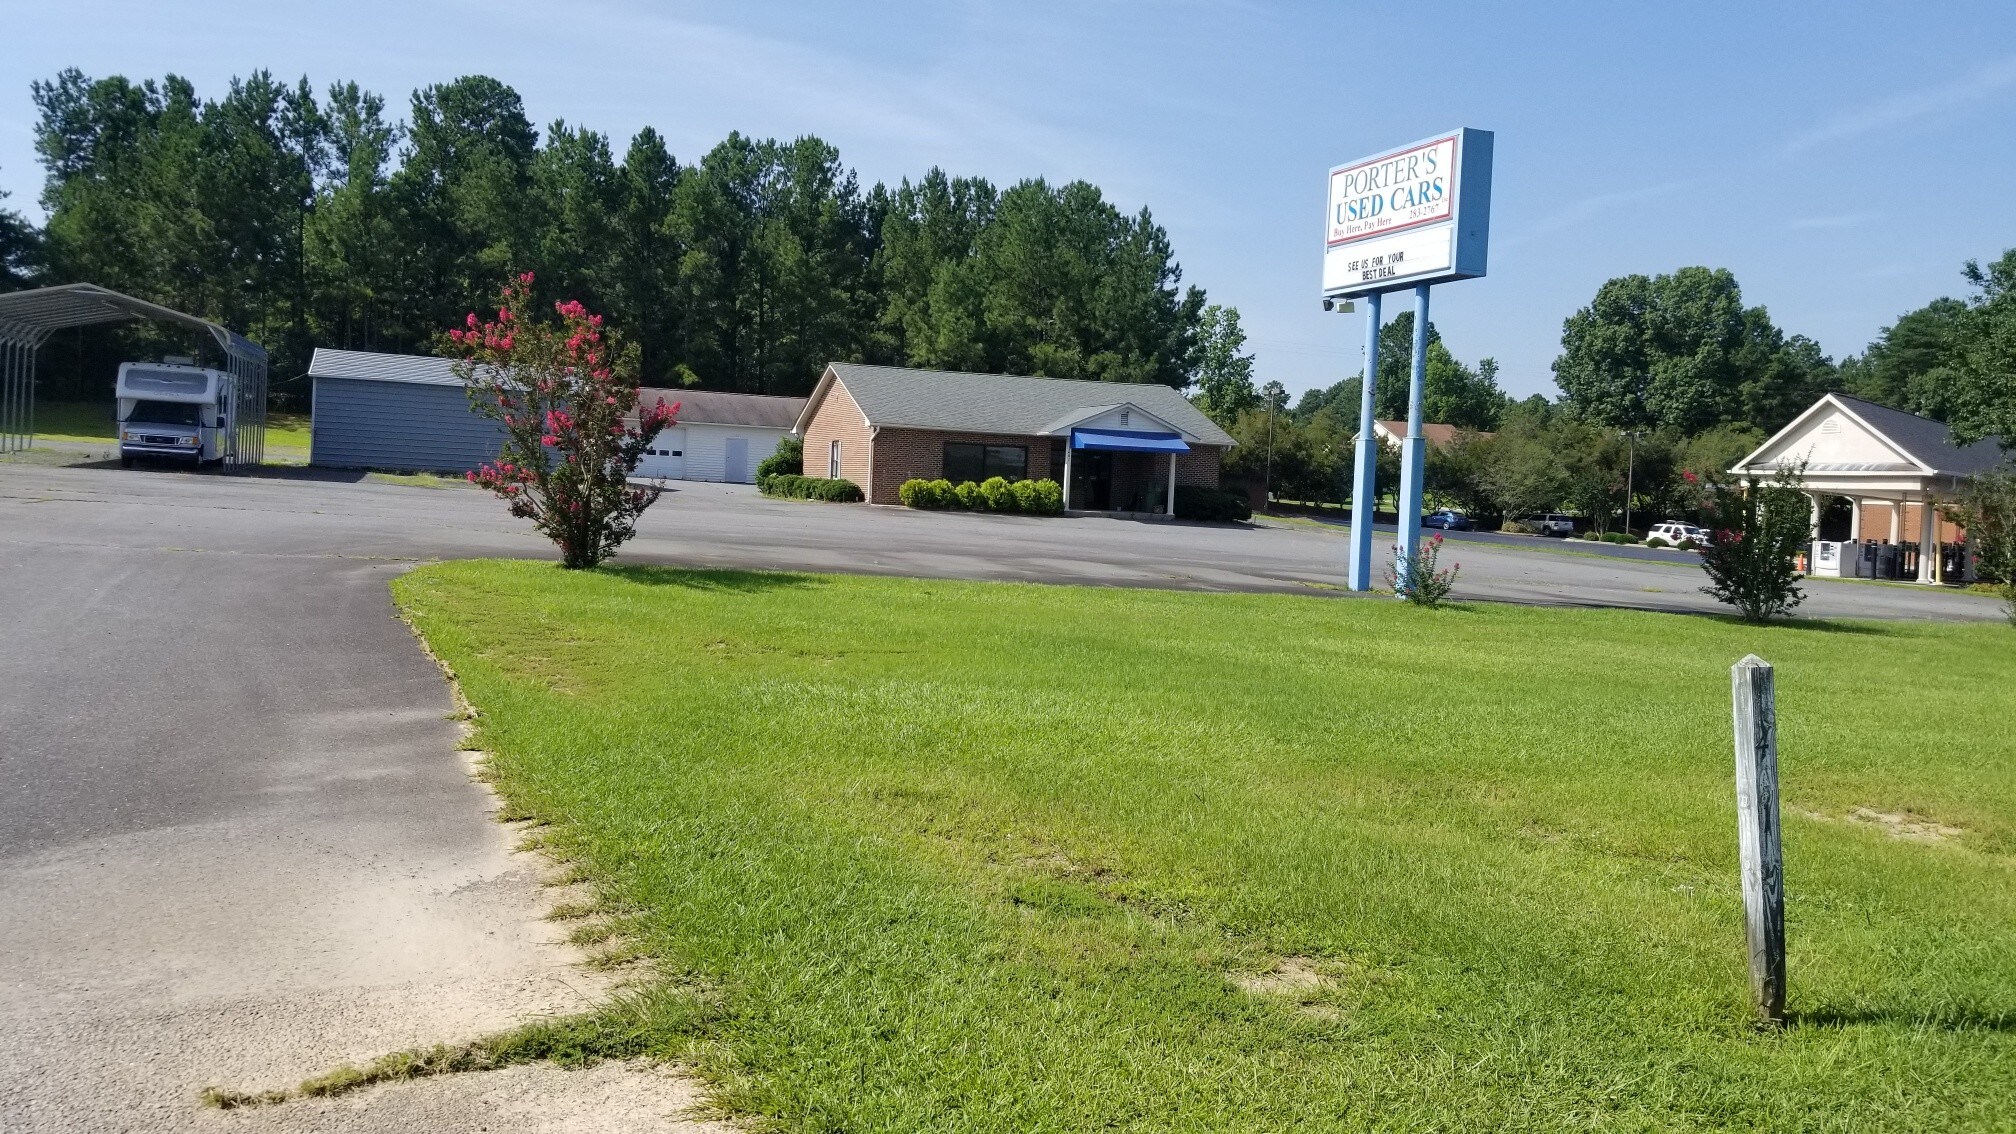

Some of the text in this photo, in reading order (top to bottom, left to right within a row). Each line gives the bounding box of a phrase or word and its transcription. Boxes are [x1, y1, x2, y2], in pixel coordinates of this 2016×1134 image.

[1342, 145, 1438, 198] PORTER'S
[1336, 176, 1444, 225] USED CARS
[1409, 203, 1439, 219] 283-2767
[1333, 228, 1344, 238] Buy
[1364, 220, 1375, 231] Pay
[1377, 217, 1392, 226] Here
[1347, 251, 1404, 272] SEE US FOR YOUR
[1362, 265, 1395, 280] BEST DEAL
